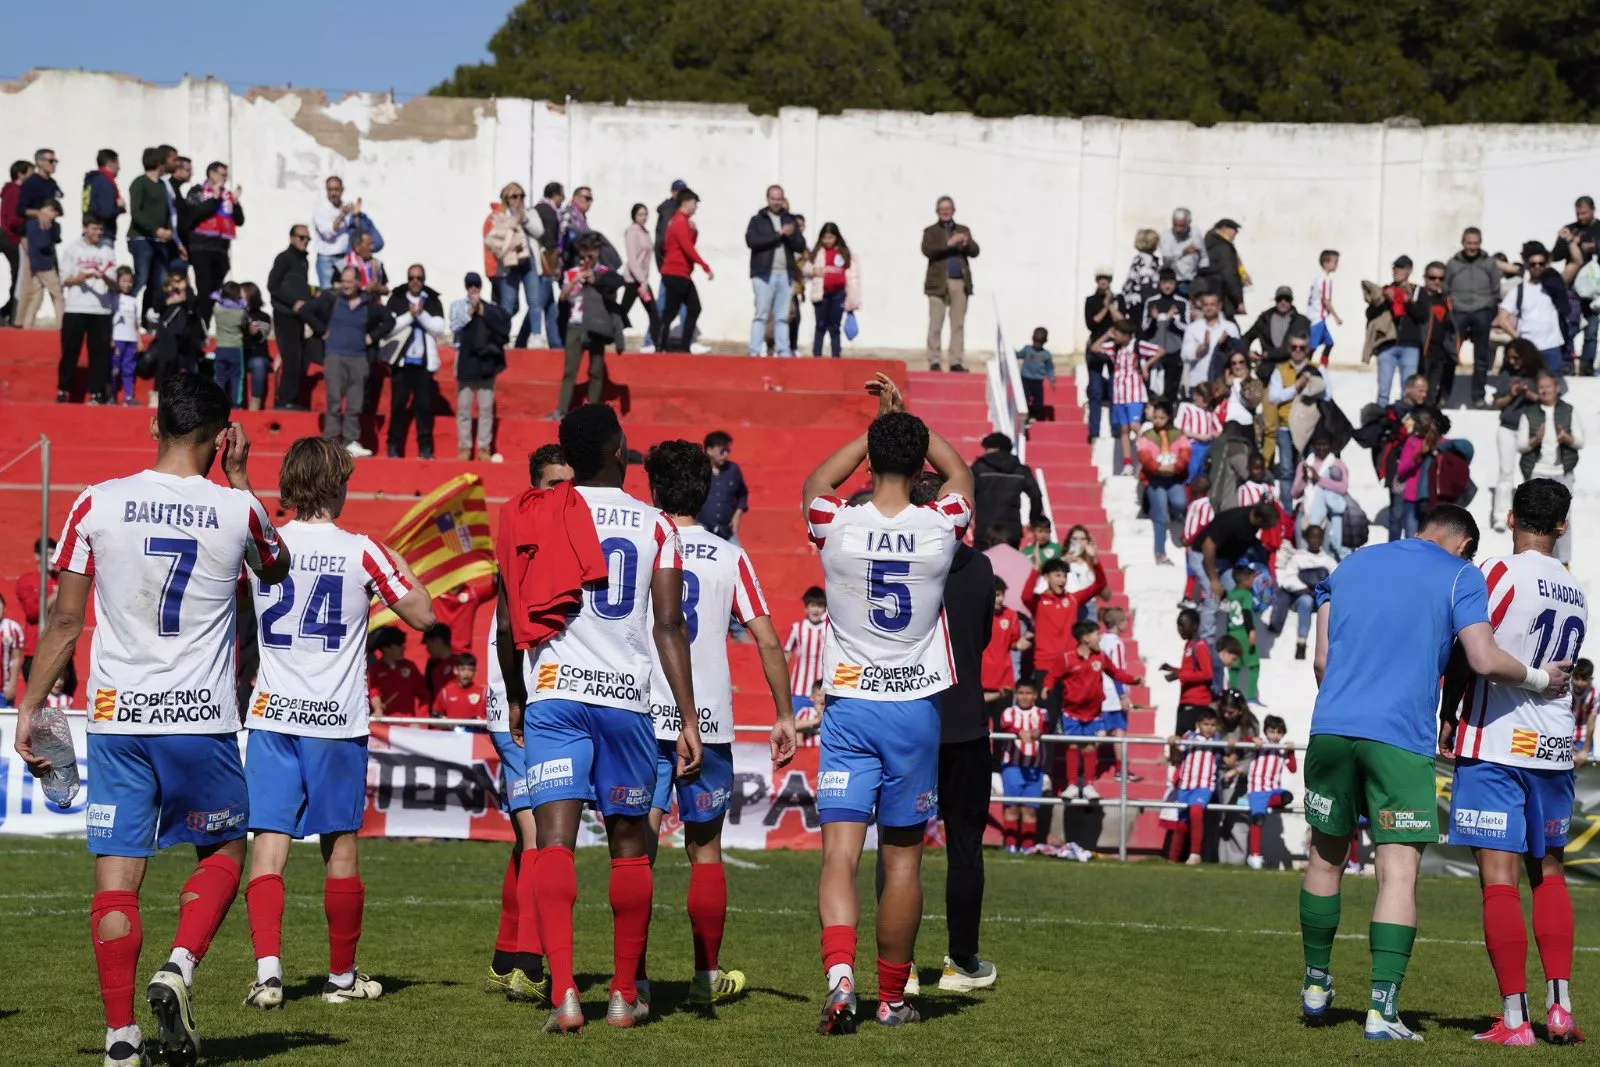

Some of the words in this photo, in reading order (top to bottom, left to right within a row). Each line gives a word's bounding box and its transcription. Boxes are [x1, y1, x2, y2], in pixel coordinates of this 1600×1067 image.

[124, 500, 219, 529] BAUTISTA
[593, 507, 641, 528] BATE
[866, 531, 916, 553] IAN
[301, 550, 347, 573] LÓPEZ
[144, 537, 198, 637] 7
[567, 536, 639, 621] 0
[866, 559, 912, 633] 5
[1537, 579, 1550, 598] EL
[258, 573, 348, 652] 24
[1529, 608, 1585, 673] 10
[560, 664, 635, 686] GOBIERNO
[860, 680, 880, 692] DE
[884, 671, 941, 692] ARAGON
[863, 664, 925, 680] GOBIERNO
[120, 688, 212, 706] GOBIERNO
[557, 677, 578, 692] DE
[583, 681, 642, 701] ARAGON
[269, 694, 340, 712] GOBIERNO
[117, 707, 142, 722] DE
[149, 704, 221, 723] ARAGON
[265, 707, 284, 720] DE
[287, 711, 347, 726] ARAGON
[1536, 747, 1553, 760] DE
[544, 763, 570, 775] siete
[824, 775, 845, 784] siete
[88, 807, 111, 821] siete
[208, 809, 230, 822] TECNO
[1395, 812, 1414, 820] TECNO
[1457, 811, 1473, 824] 24
[1480, 815, 1504, 826] siete
[1456, 826, 1507, 839] PRODUCCIONES
